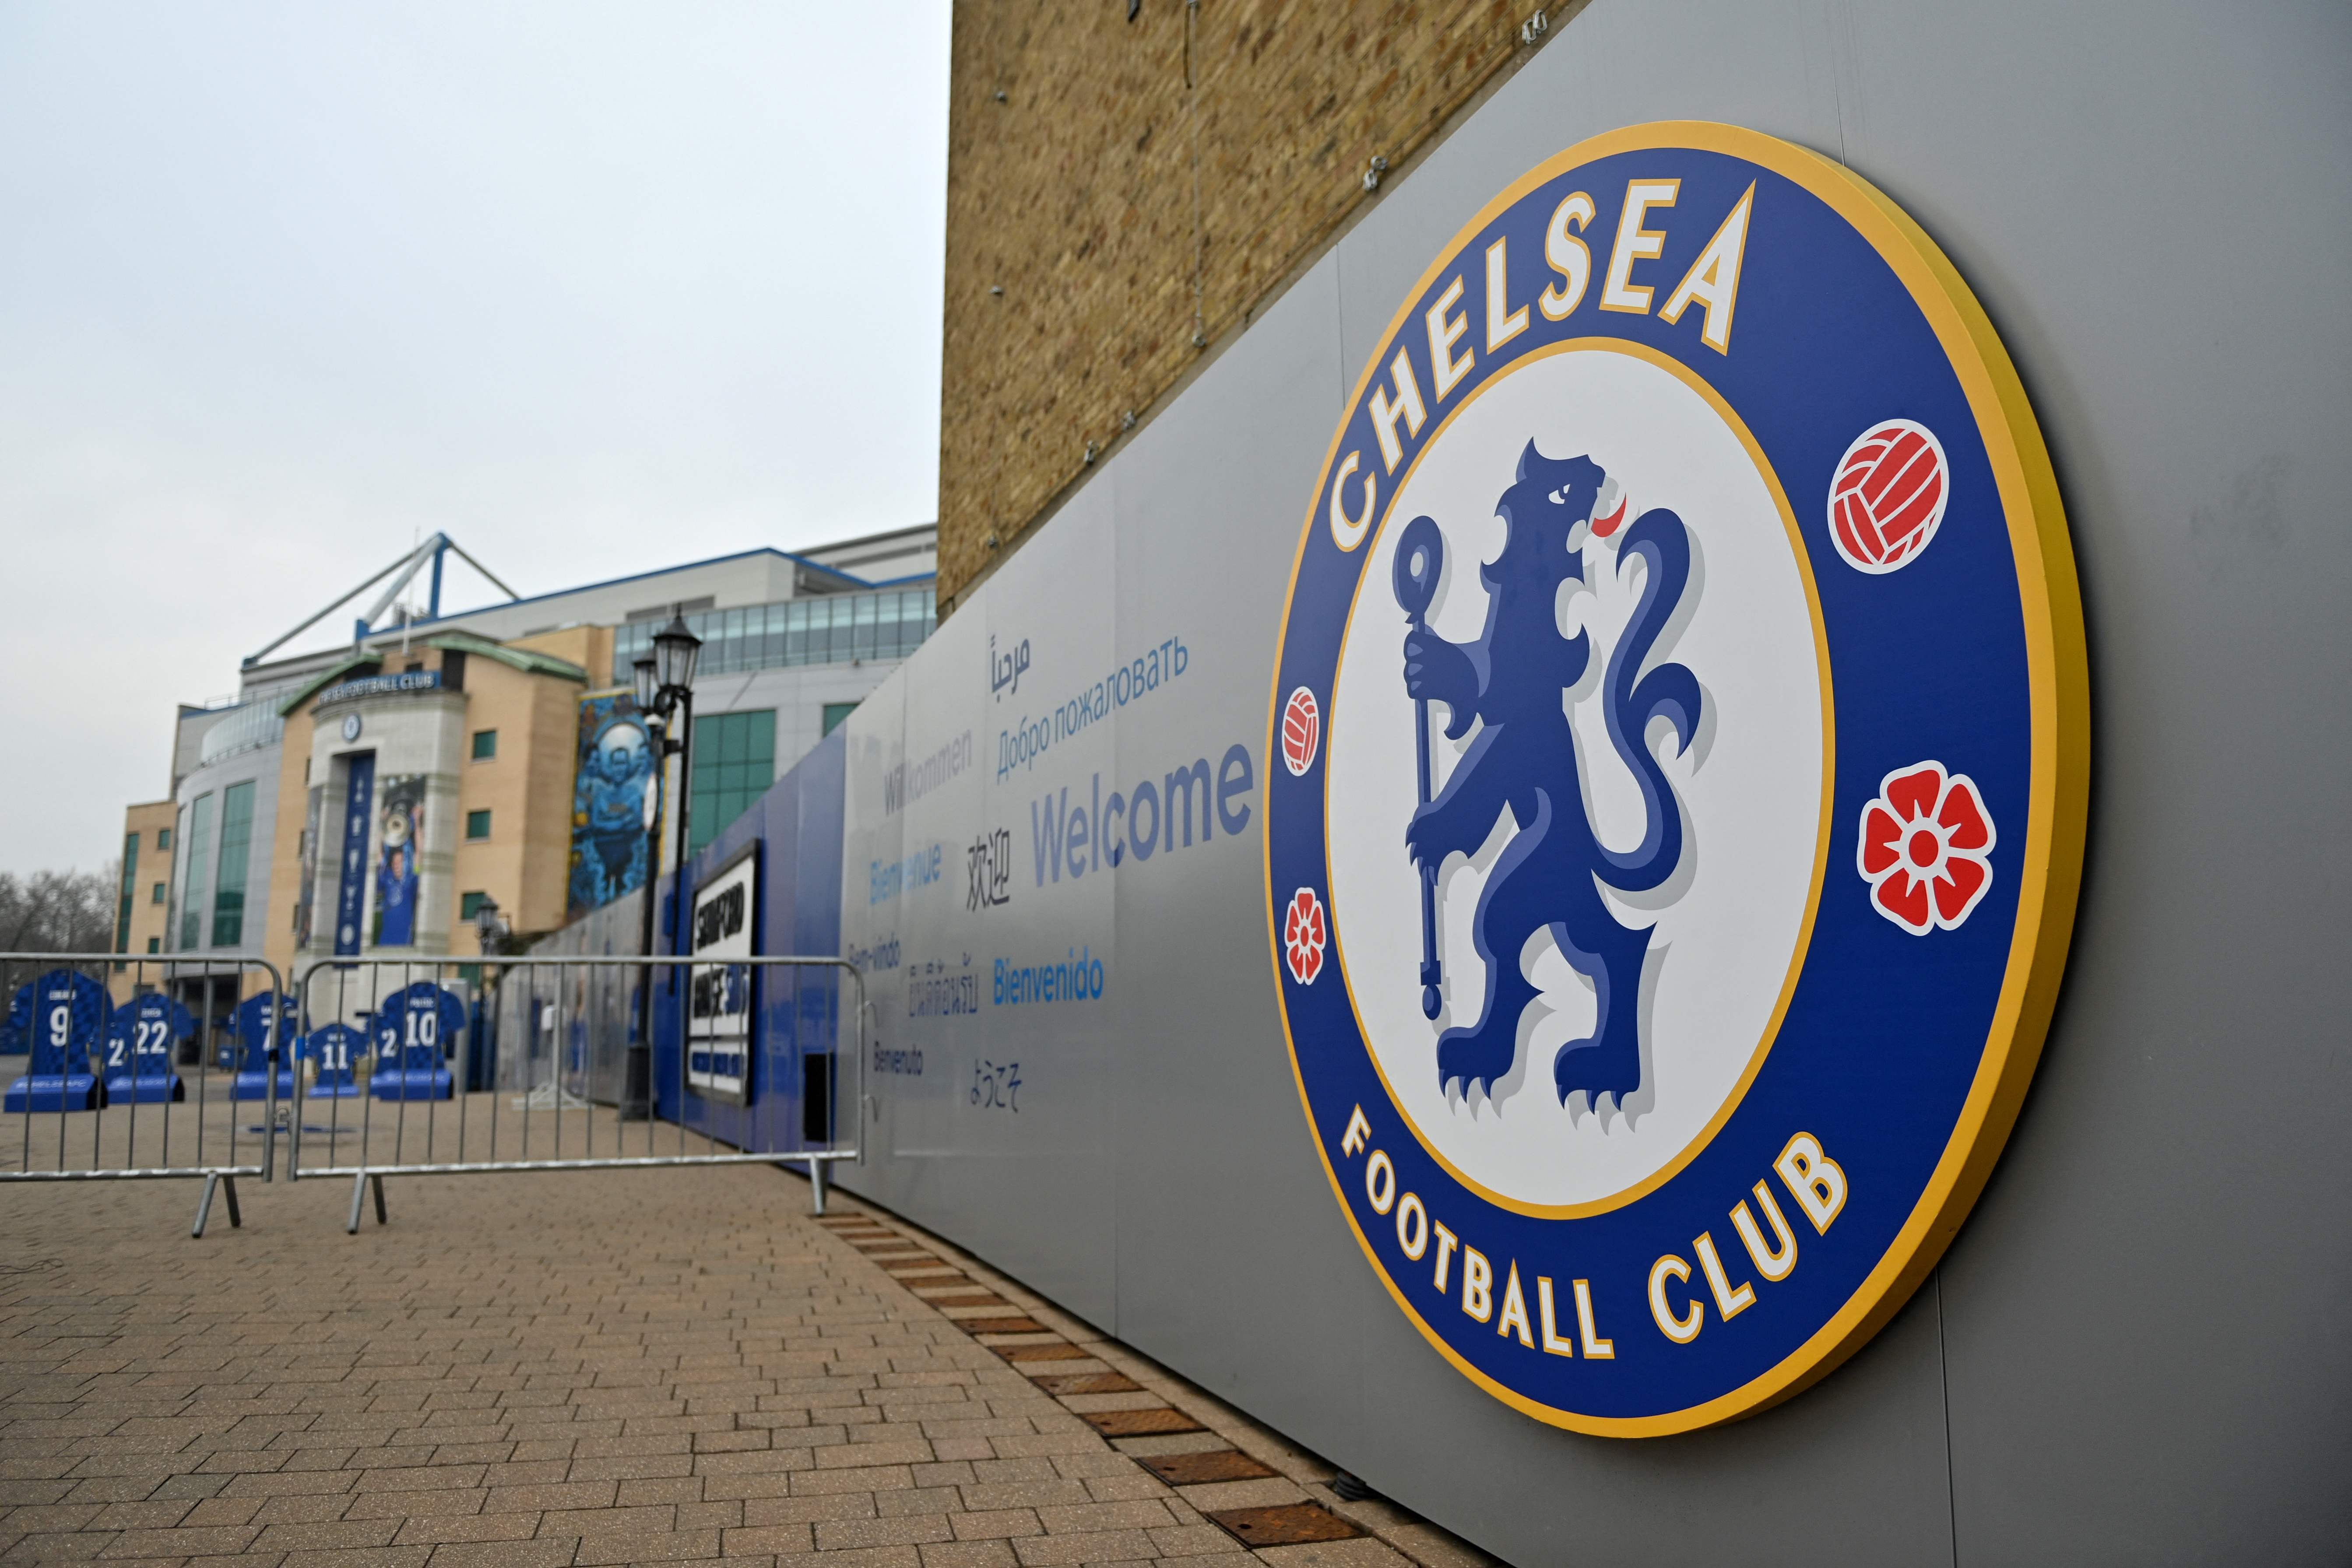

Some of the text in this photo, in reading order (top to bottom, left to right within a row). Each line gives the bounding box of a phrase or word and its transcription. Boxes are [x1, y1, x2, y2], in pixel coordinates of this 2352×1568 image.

[1330, 178, 1756, 552] CHELSEA
[400, 672, 435, 690] CLUB
[997, 636, 1188, 786] Добро пожаловать
[883, 729, 972, 817] Willkommen
[1031, 744, 1253, 888] Welcome
[869, 843, 942, 906] Bienvenue
[967, 828, 1010, 913] 欢迎
[993, 946, 1104, 1005] Bienvenido
[49, 1005, 73, 1047] 9
[132, 1020, 169, 1054] 22
[405, 1011, 440, 1047] 10
[322, 1043, 349, 1070] 11
[874, 1040, 923, 1076] Benvenuto
[970, 1058, 1022, 1113] ようこそ
[1341, 1103, 1848, 1359] FOOTBALL CLUB
